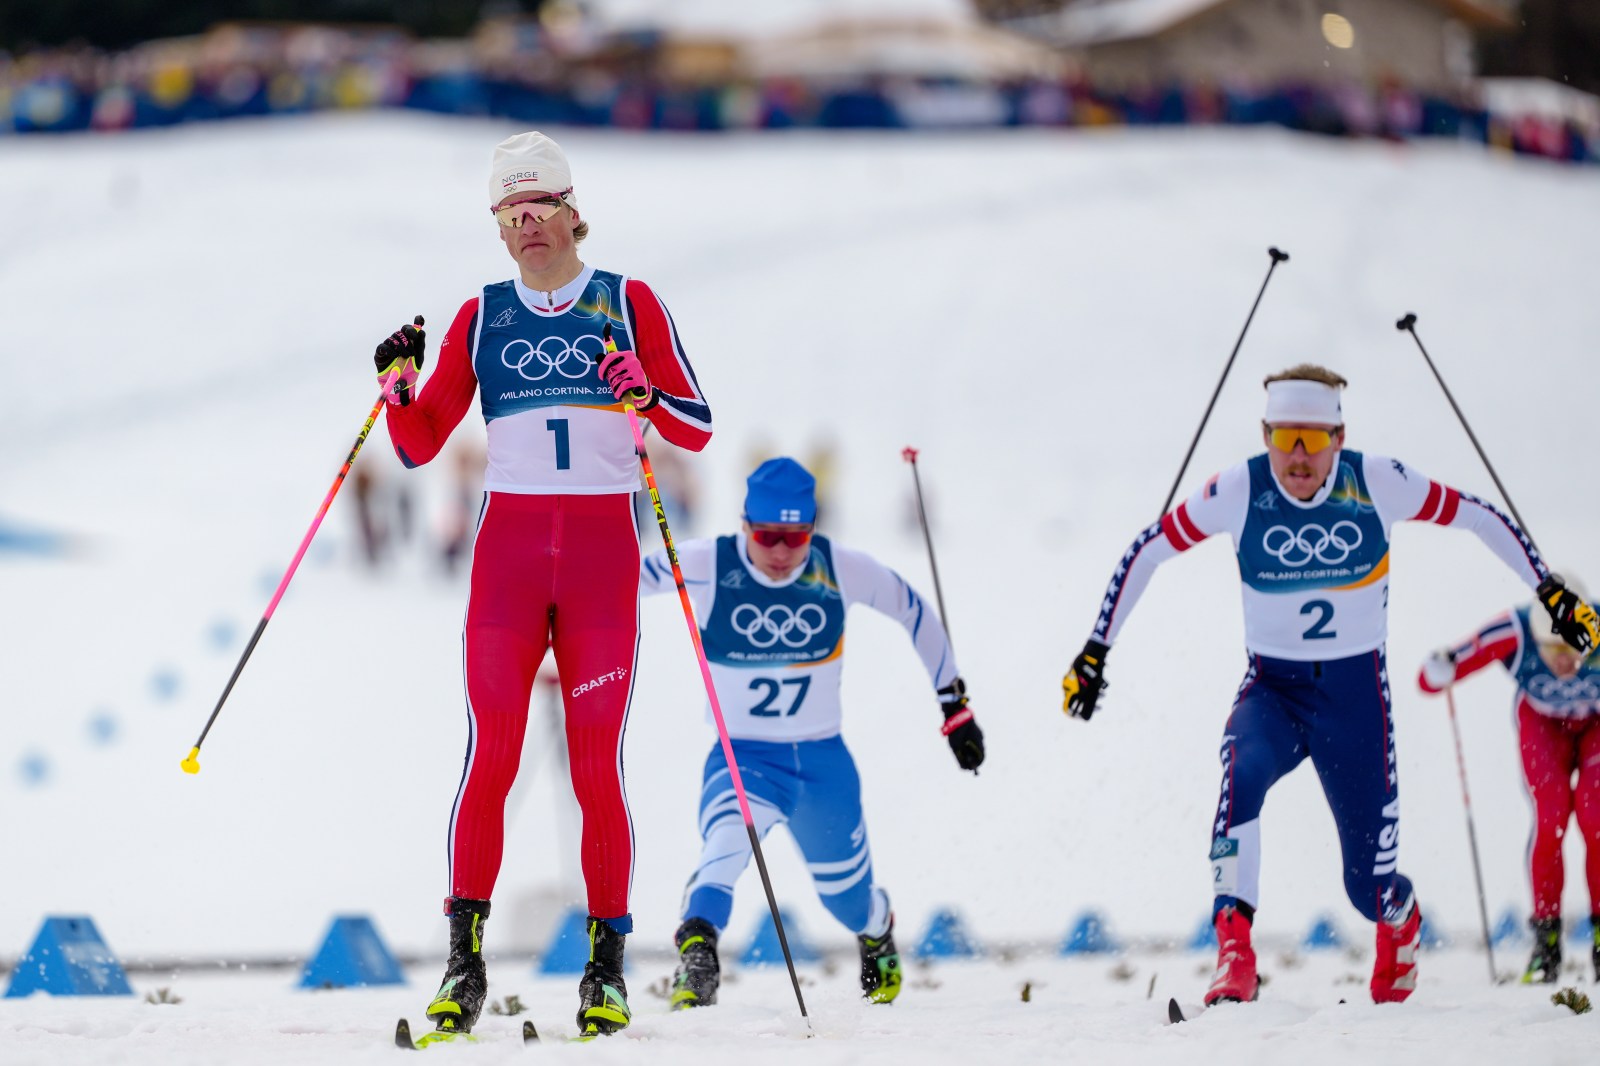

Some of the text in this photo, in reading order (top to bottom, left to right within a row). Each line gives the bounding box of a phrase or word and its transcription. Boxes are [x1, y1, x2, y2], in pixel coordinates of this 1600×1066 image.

[502, 171, 538, 185] NORGE
[499, 386, 612, 401] MILANO CORTINA 202
[546, 418, 570, 470] 1
[644, 472, 666, 524] LEKI
[1257, 570, 1301, 581] MILANO
[1303, 568, 1351, 580] CORTINA
[1299, 598, 1337, 640] 2
[572, 671, 616, 698] CRAFT
[748, 674, 812, 717] 27
[1373, 798, 1400, 876] USA
[1214, 865, 1223, 883] 2
